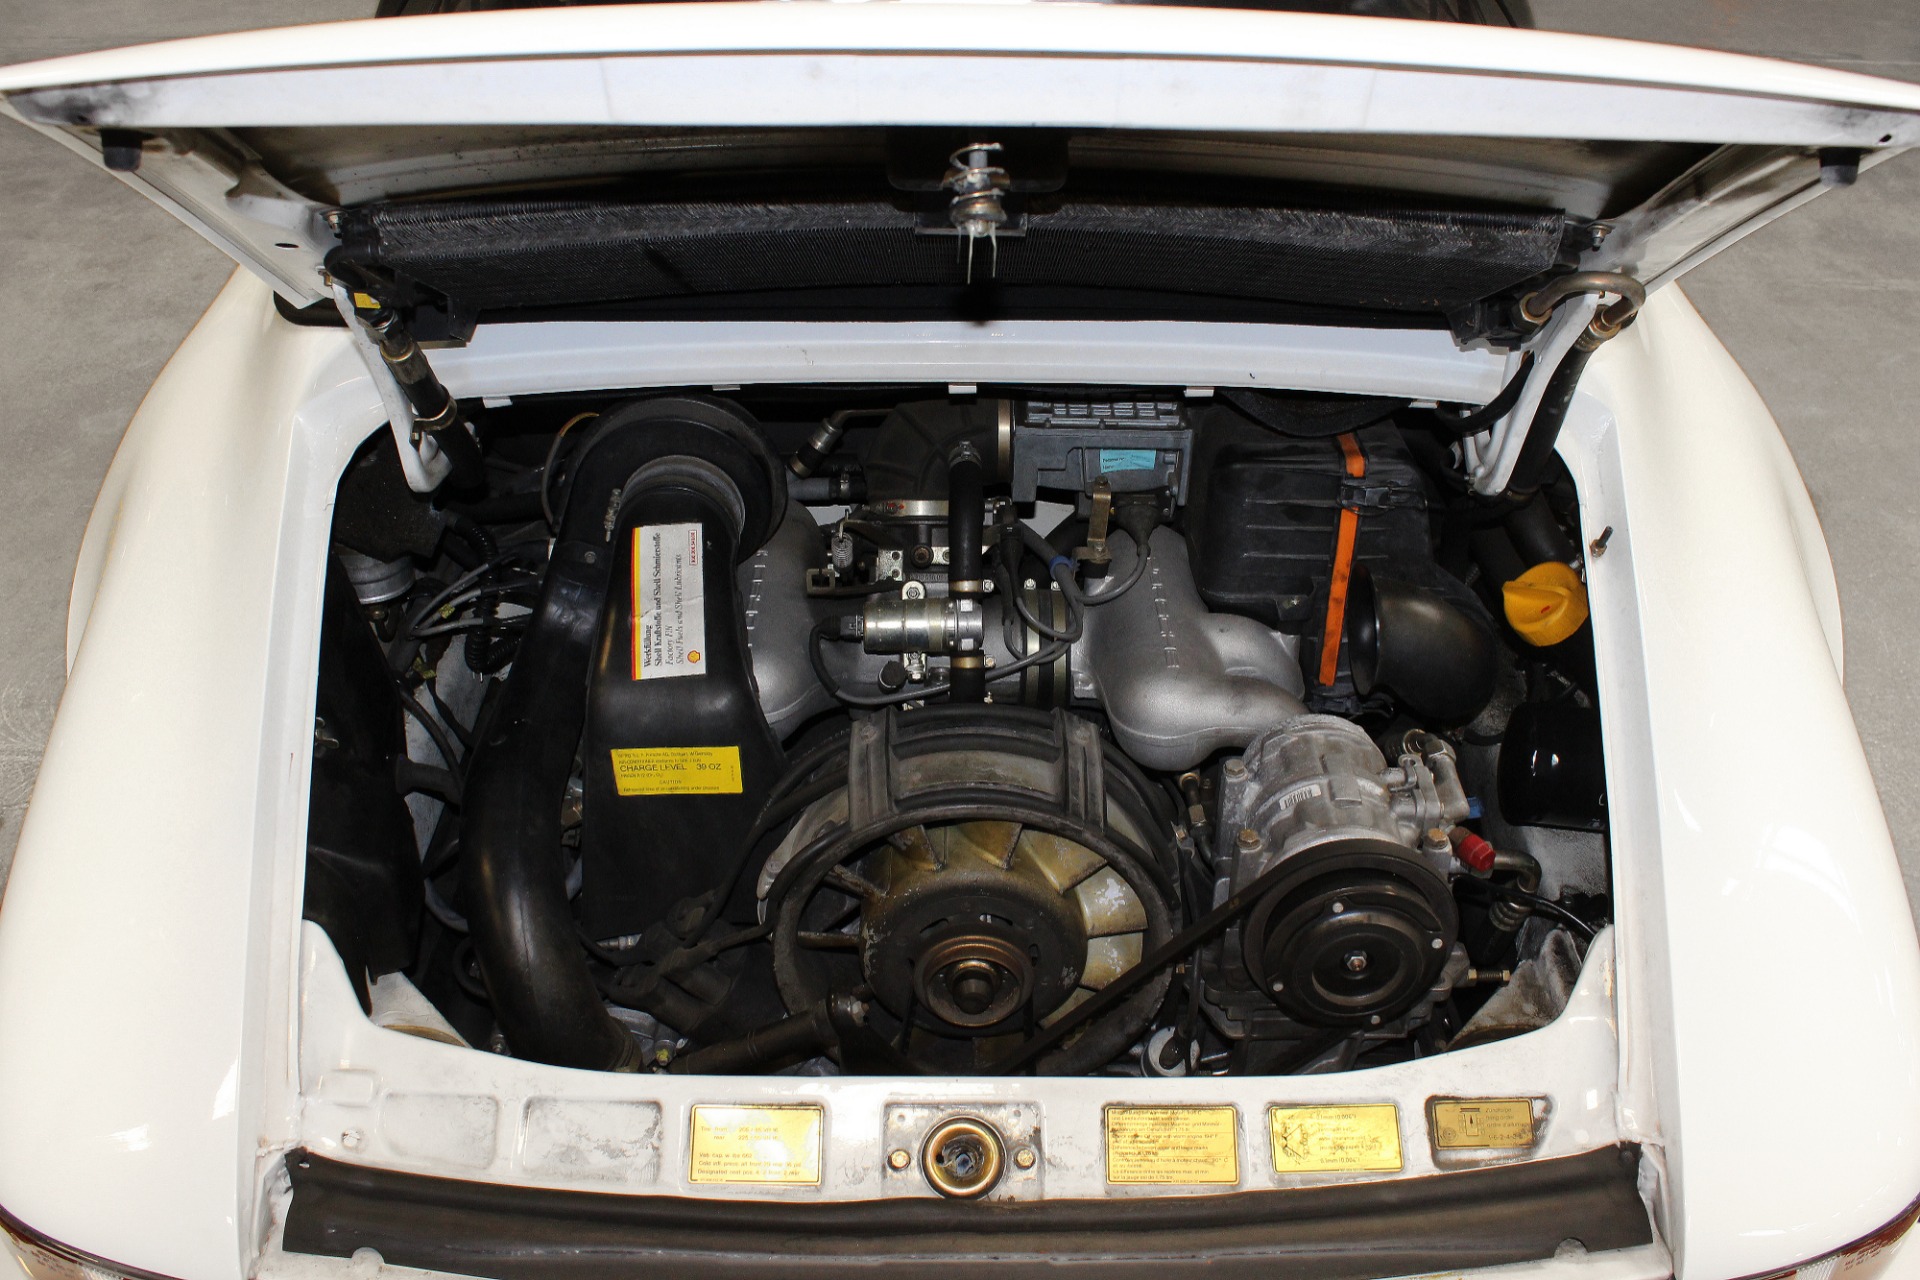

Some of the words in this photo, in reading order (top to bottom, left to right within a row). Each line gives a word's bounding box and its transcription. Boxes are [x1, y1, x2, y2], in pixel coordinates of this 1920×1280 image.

[653, 532, 661, 577] Schmierstoffe
[674, 554, 682, 590] Lubricants
[653, 578, 661, 596] Shell
[675, 591, 683, 609] Shell
[675, 610, 683, 624] and
[675, 626, 683, 644] Fuels
[654, 648, 662, 666] Shell
[665, 640, 674, 665] Factory
[676, 646, 684, 664] Shell
[620, 763, 659, 772] CHARGE
[660, 762, 687, 771] LEVEL
